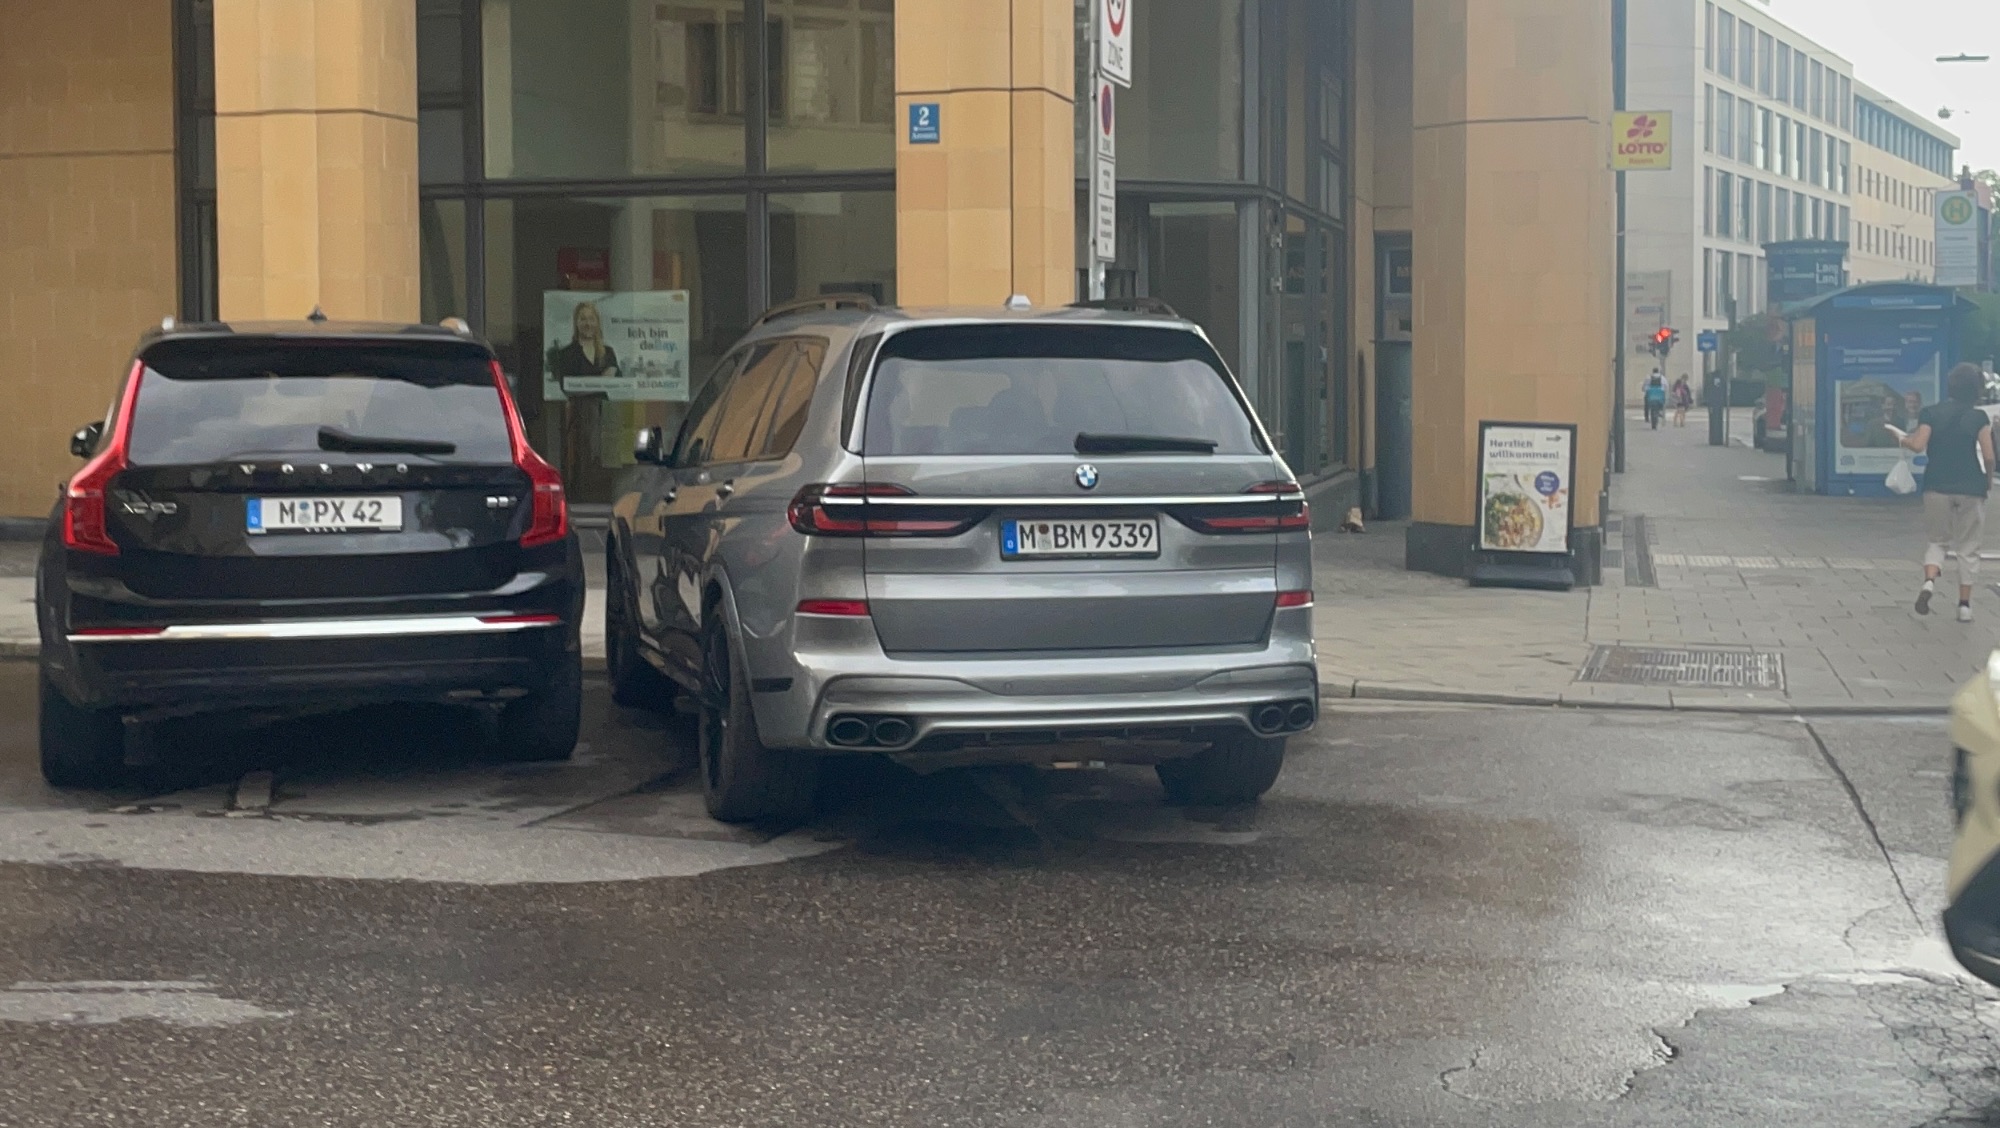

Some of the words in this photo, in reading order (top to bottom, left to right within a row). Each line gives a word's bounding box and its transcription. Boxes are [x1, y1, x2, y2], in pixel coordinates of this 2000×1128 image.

[1107, 40, 1124, 71] ZONE
[919, 106, 930, 126] 2
[1618, 142, 1665, 155] LOTTO
[627, 327, 647, 339] Ich
[650, 327, 669, 339] bin
[1490, 439, 1533, 448] Herzlich
[1489, 450, 1560, 460] willkommen!
[239, 463, 409, 475] VOLVO
[280, 501, 296, 523] M
[314, 501, 344, 523] PX
[352, 501, 384, 522] 42
[1019, 524, 1037, 549] M
[1053, 524, 1087, 549] BM
[1091, 523, 1154, 549] 9339
